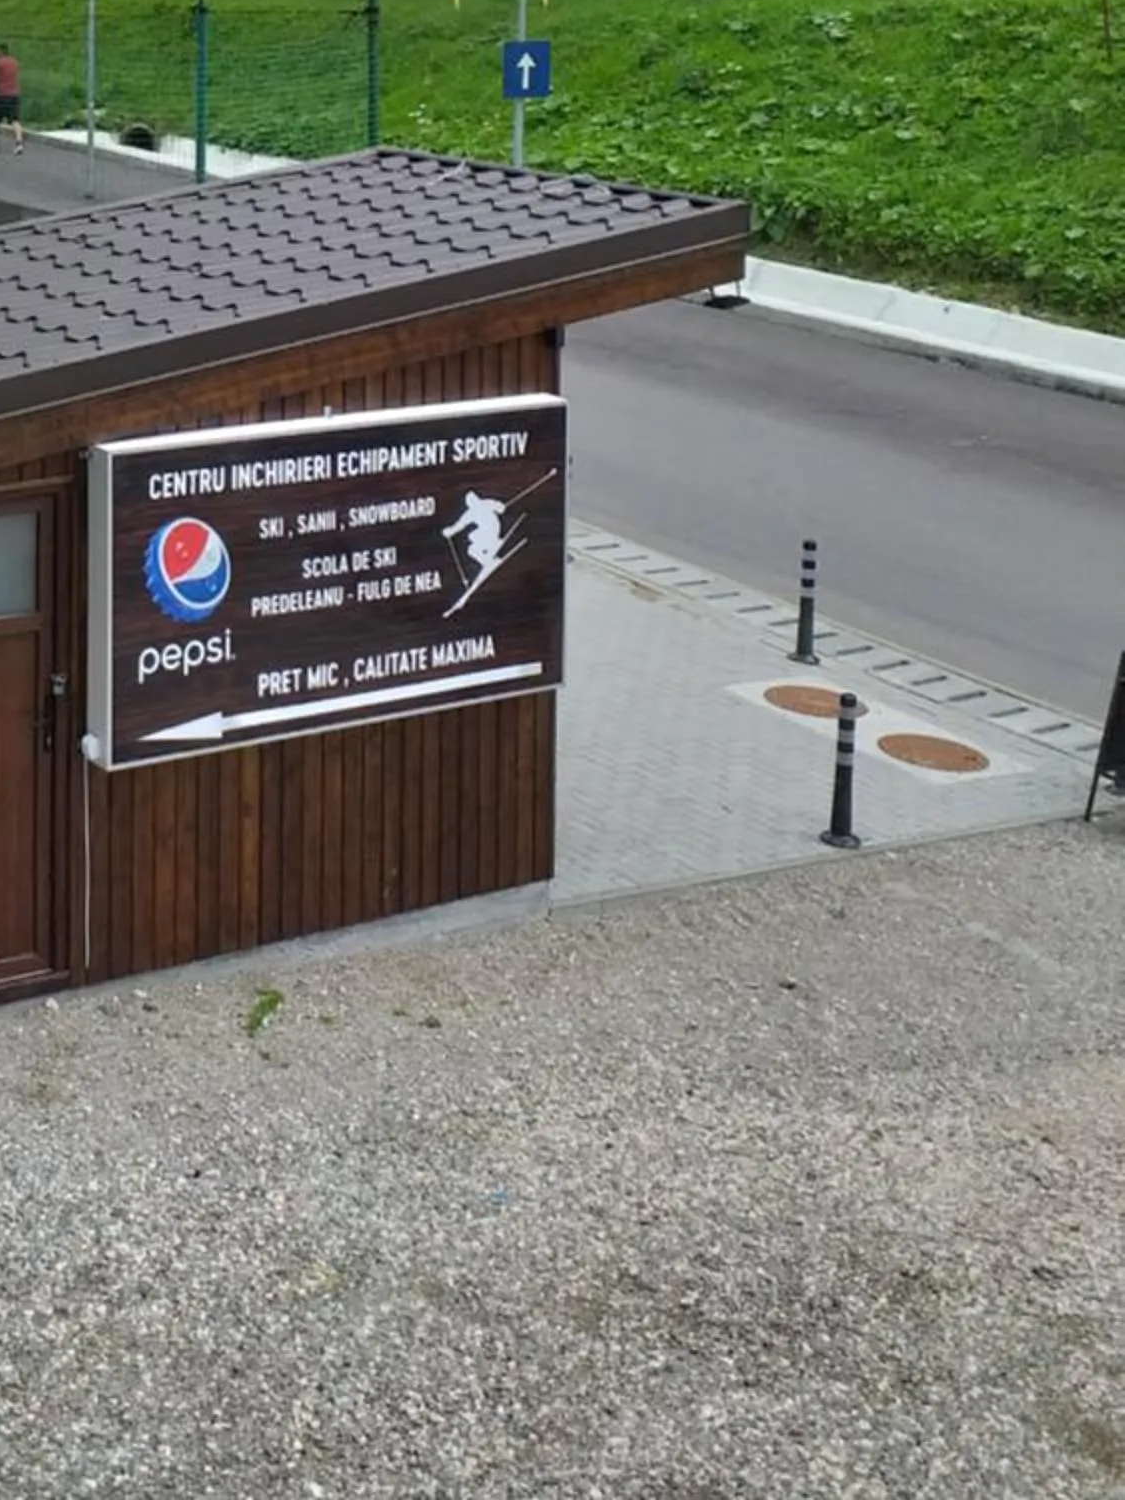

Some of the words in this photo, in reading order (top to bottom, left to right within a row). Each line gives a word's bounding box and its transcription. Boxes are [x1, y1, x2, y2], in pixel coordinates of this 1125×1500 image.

[148, 465, 226, 500] CENTRU
[231, 453, 332, 492] INCHIRIERI
[337, 439, 449, 478] ECHIPAMENT
[452, 431, 529, 463] SPORTIV
[259, 516, 284, 540] SKI
[297, 510, 337, 535] SANII
[348, 496, 436, 527] SNOWBOARD
[301, 553, 349, 579] SCOLA
[352, 550, 371, 573] DE
[374, 546, 397, 569] SKI
[250, 586, 344, 618] PREDELEANU
[357, 577, 391, 603] FULG
[394, 574, 412, 596] DE
[415, 570, 442, 593] NEA
[138, 628, 231, 684] pepsi
[258, 668, 302, 698] PRET
[307, 661, 338, 688] MIC
[353, 647, 428, 681] CALITATE
[431, 634, 495, 669] MAXIMA
